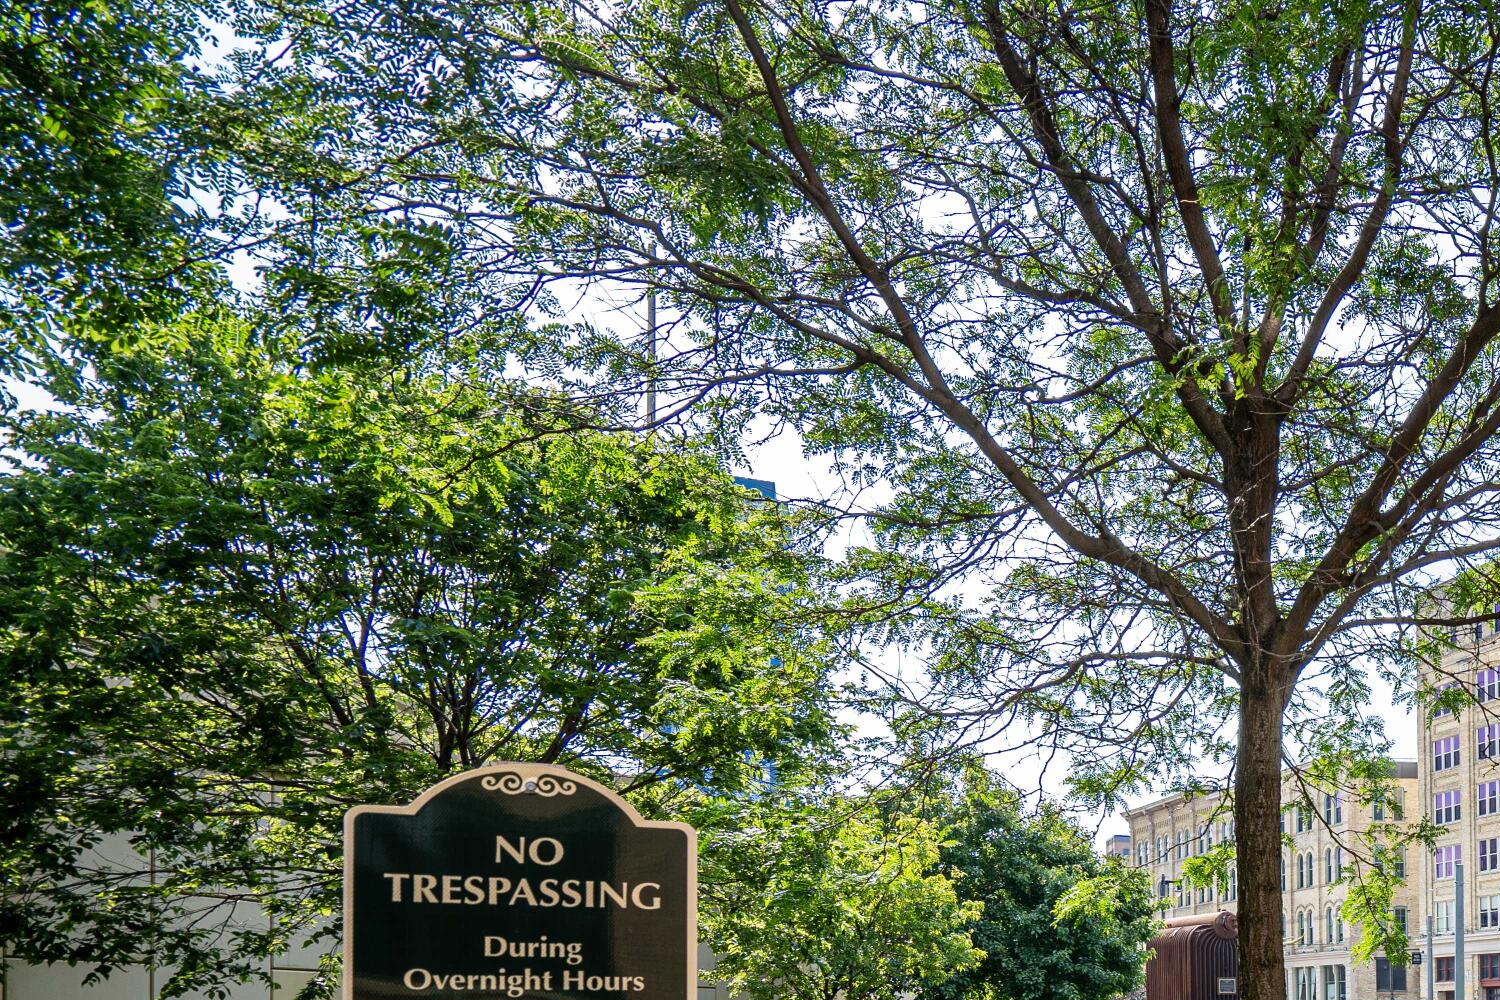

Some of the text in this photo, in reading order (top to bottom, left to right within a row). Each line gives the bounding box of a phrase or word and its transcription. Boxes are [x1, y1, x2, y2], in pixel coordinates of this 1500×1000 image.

[495, 835, 565, 866] NO
[383, 873, 662, 910] TRESPASSING
[484, 935, 583, 965] During
[403, 968, 645, 998] Overnight Hours
